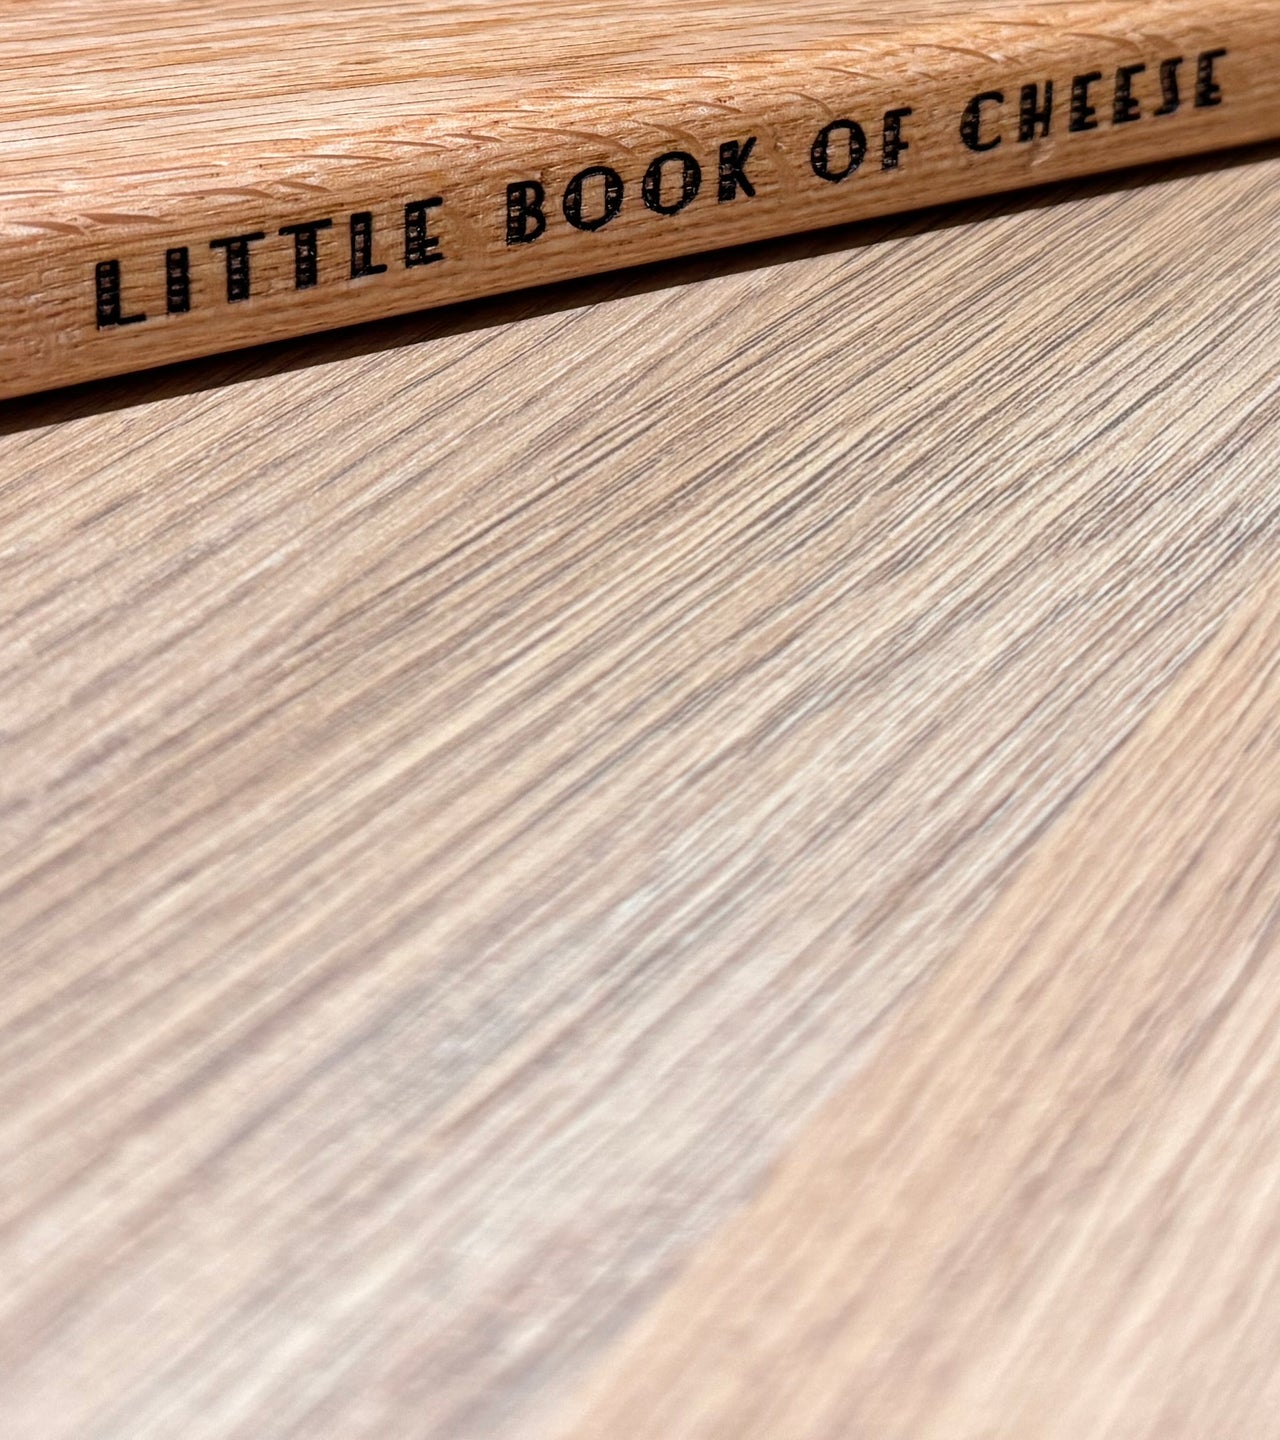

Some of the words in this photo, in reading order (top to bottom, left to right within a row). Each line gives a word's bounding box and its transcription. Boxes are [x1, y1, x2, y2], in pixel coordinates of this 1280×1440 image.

[96, 197, 443, 328] LITTLE
[505, 136, 757, 245] BOOK
[810, 107, 912, 185] OF
[960, 49, 1227, 152] CHEESE
